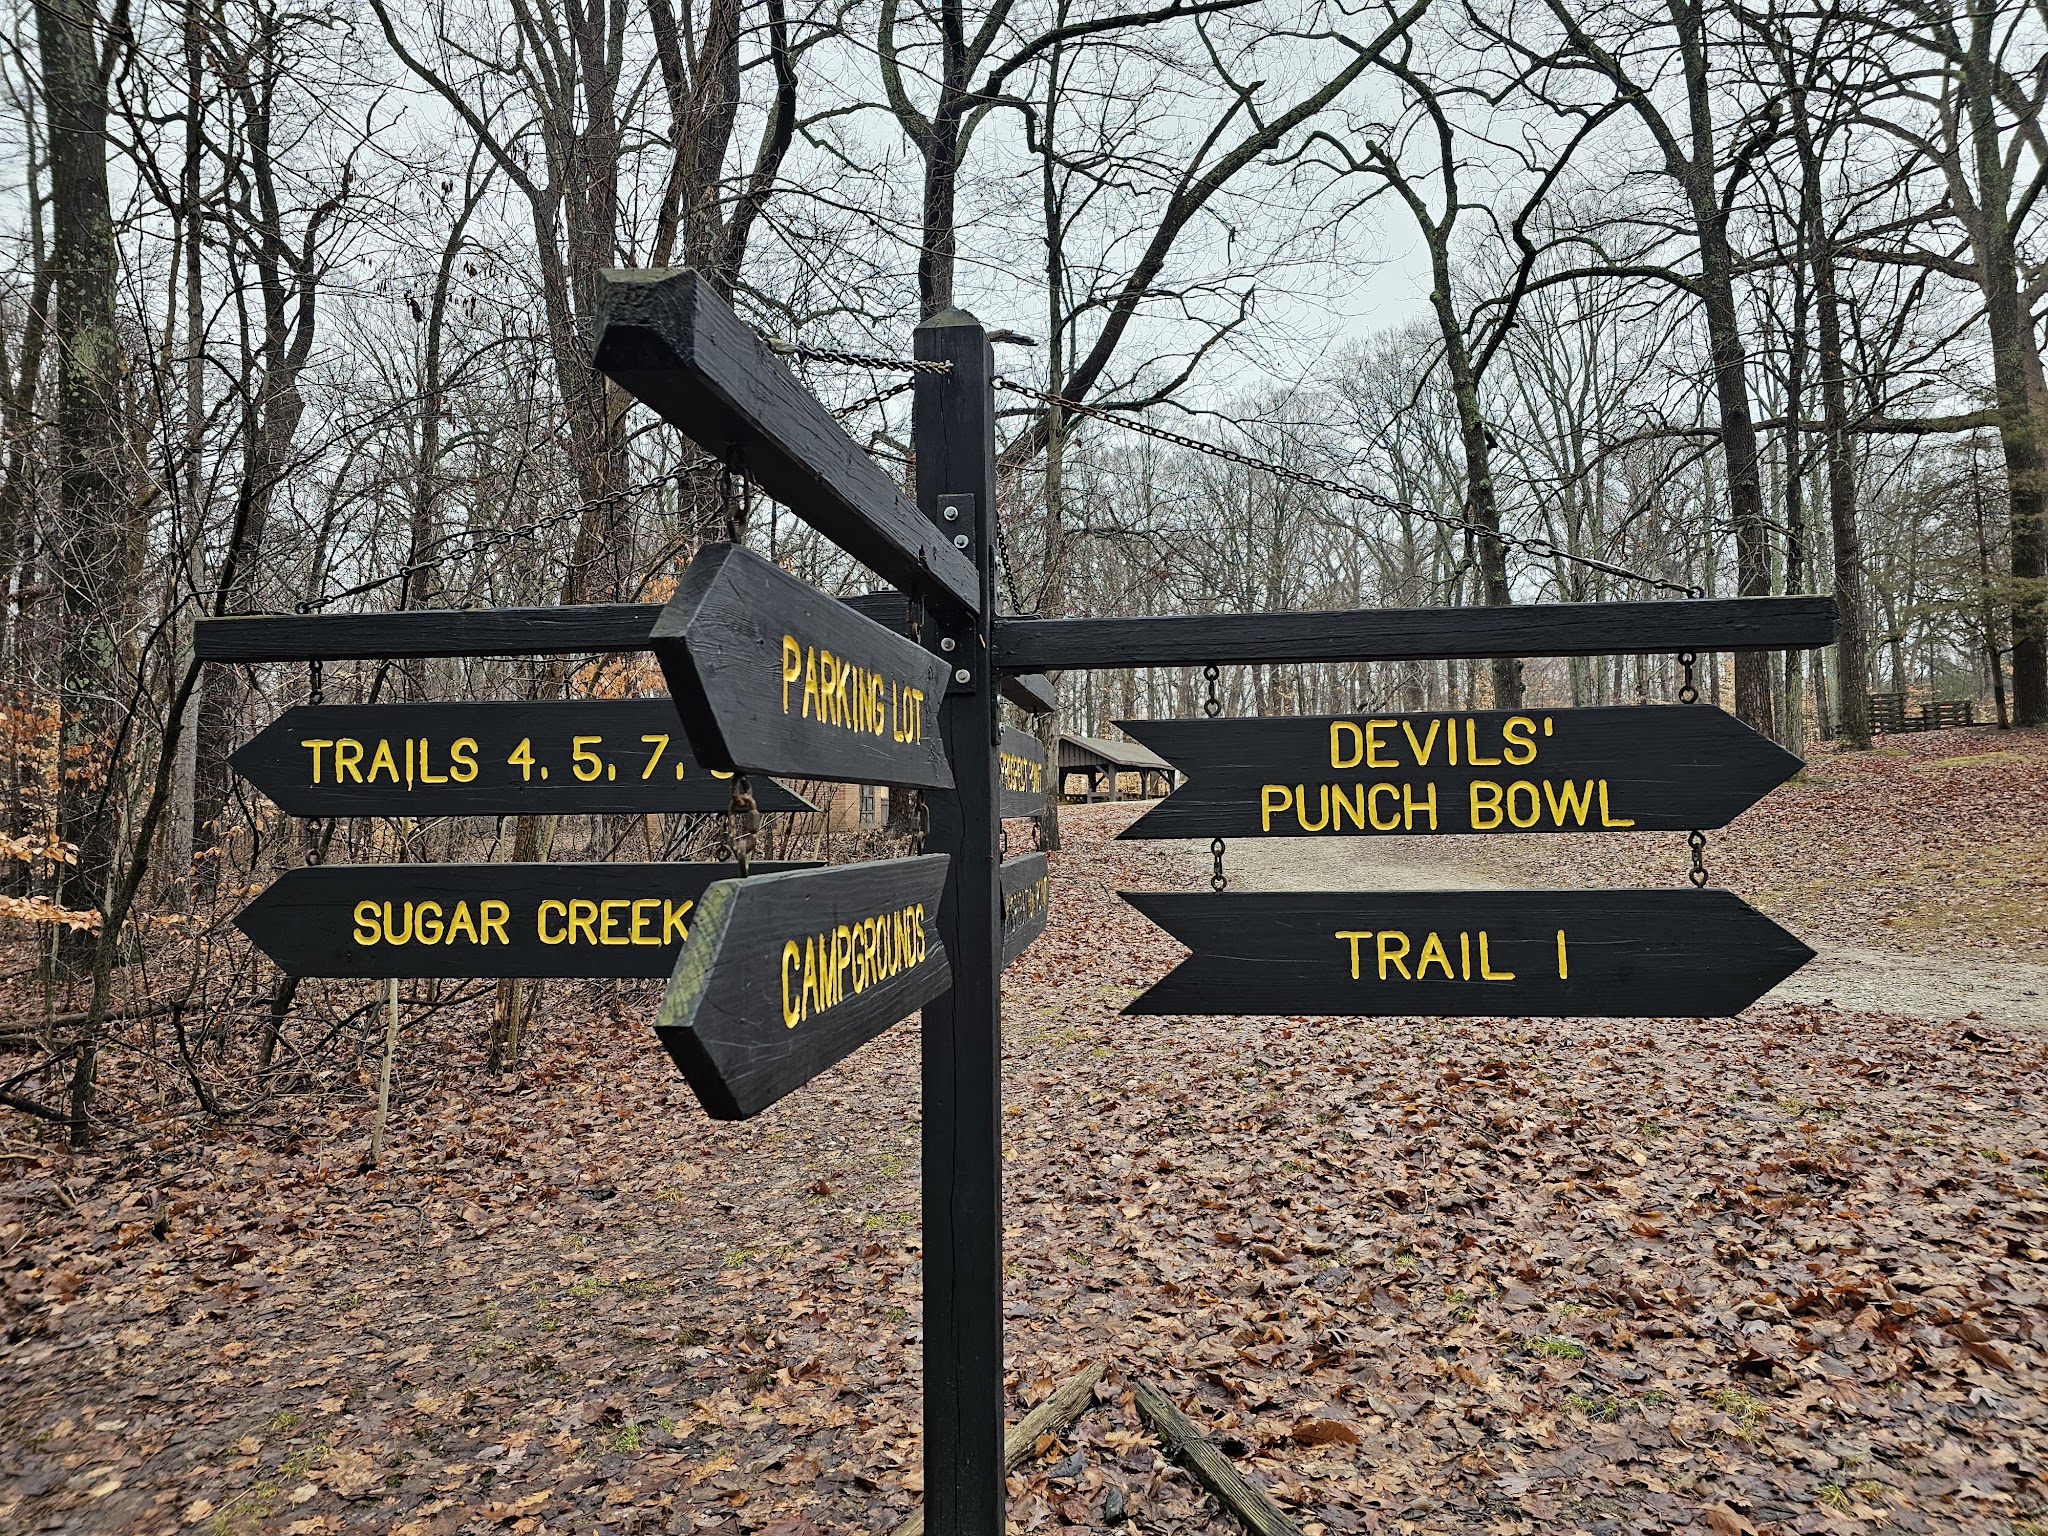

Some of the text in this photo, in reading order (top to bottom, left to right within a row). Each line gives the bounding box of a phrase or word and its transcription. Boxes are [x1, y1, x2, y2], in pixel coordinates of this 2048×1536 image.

[782, 634, 924, 745] PARKING LOT
[301, 734, 685, 790] TRAILS 4, 5, 7,
[1329, 716, 1554, 769] DEVILS'
[1261, 778, 1636, 832] PUNCH BOWL
[353, 898, 694, 946] SUGAR CREEK
[781, 903, 925, 1034] CAMPGROUNDS
[1334, 930, 1516, 981] TRAIL
